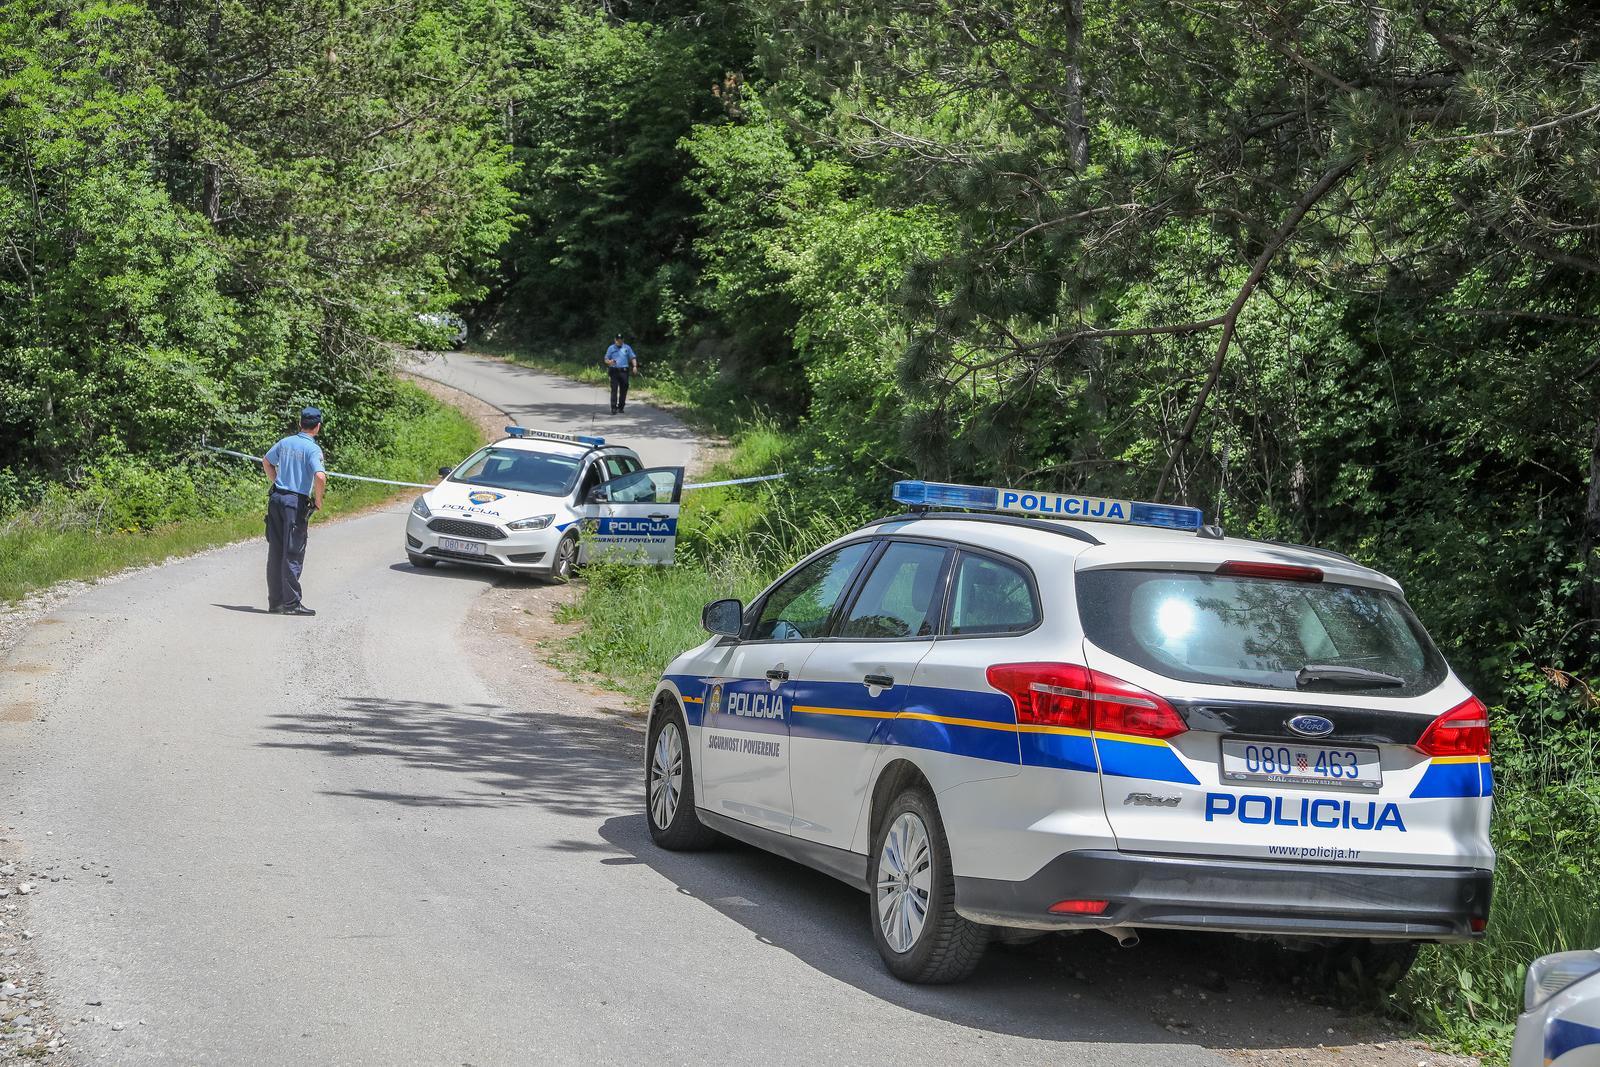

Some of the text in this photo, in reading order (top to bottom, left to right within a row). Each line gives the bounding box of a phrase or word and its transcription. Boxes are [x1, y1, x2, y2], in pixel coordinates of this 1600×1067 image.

[531, 430, 571, 441] POLICIJA
[442, 504, 500, 517] POLICIJA
[1003, 491, 1125, 519] POLICIJA
[609, 521, 670, 532] POLICIJA
[445, 540, 479, 552] 080 475
[727, 692, 784, 720] POLICIJA
[1300, 718, 1326, 731] Ford
[709, 735, 740, 752] SIGURNOST
[743, 739, 780, 758] POVJERENJE
[1246, 745, 1359, 779] 080 463
[1267, 775, 1287, 783] SIAL
[1205, 792, 1407, 832] POLICIJA
[1269, 844, 1361, 860] www.policija.hr
